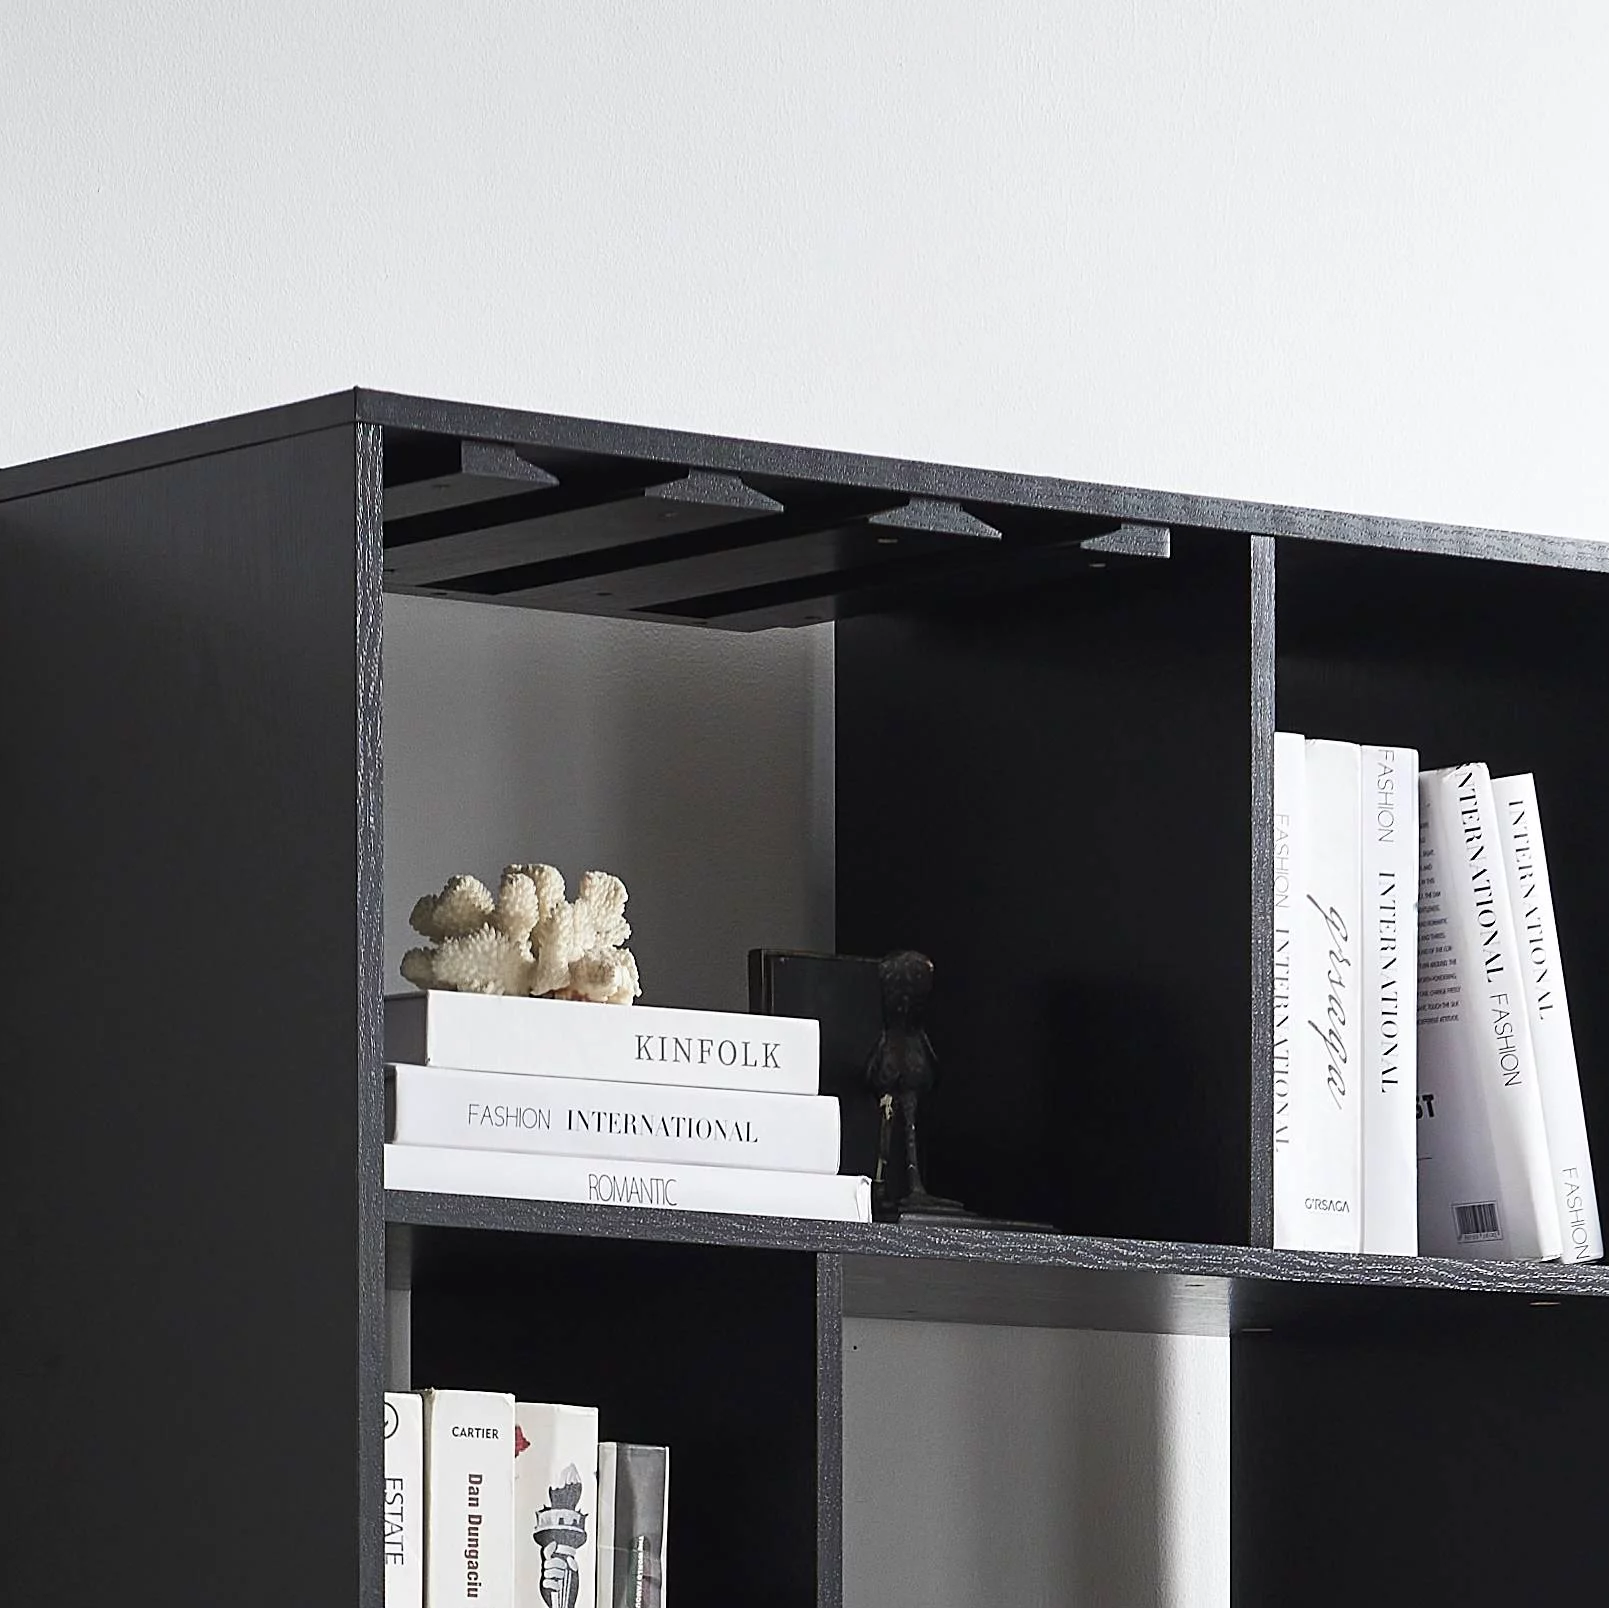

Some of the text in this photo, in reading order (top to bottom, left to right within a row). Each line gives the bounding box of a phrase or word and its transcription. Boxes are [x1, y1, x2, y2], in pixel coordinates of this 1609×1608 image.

[1377, 749, 1399, 1094] FASHION INTERNATIONAL
[1274, 813, 1289, 1152] FASHION INTERNATIONAL
[635, 1035, 781, 1069] KINFOLK
[1489, 993, 1522, 1088] FASHION
[1509, 799, 1593, 1262] INTERNATIONAL FASHION
[468, 1104, 758, 1143] FASHION INTERNATIONAL
[588, 1174, 678, 1206] ROMANTIC
[451, 1425, 499, 1440] CARTIER
[385, 1478, 404, 1565] ESTATE
[464, 1473, 483, 1599] Dan Dungaciu
